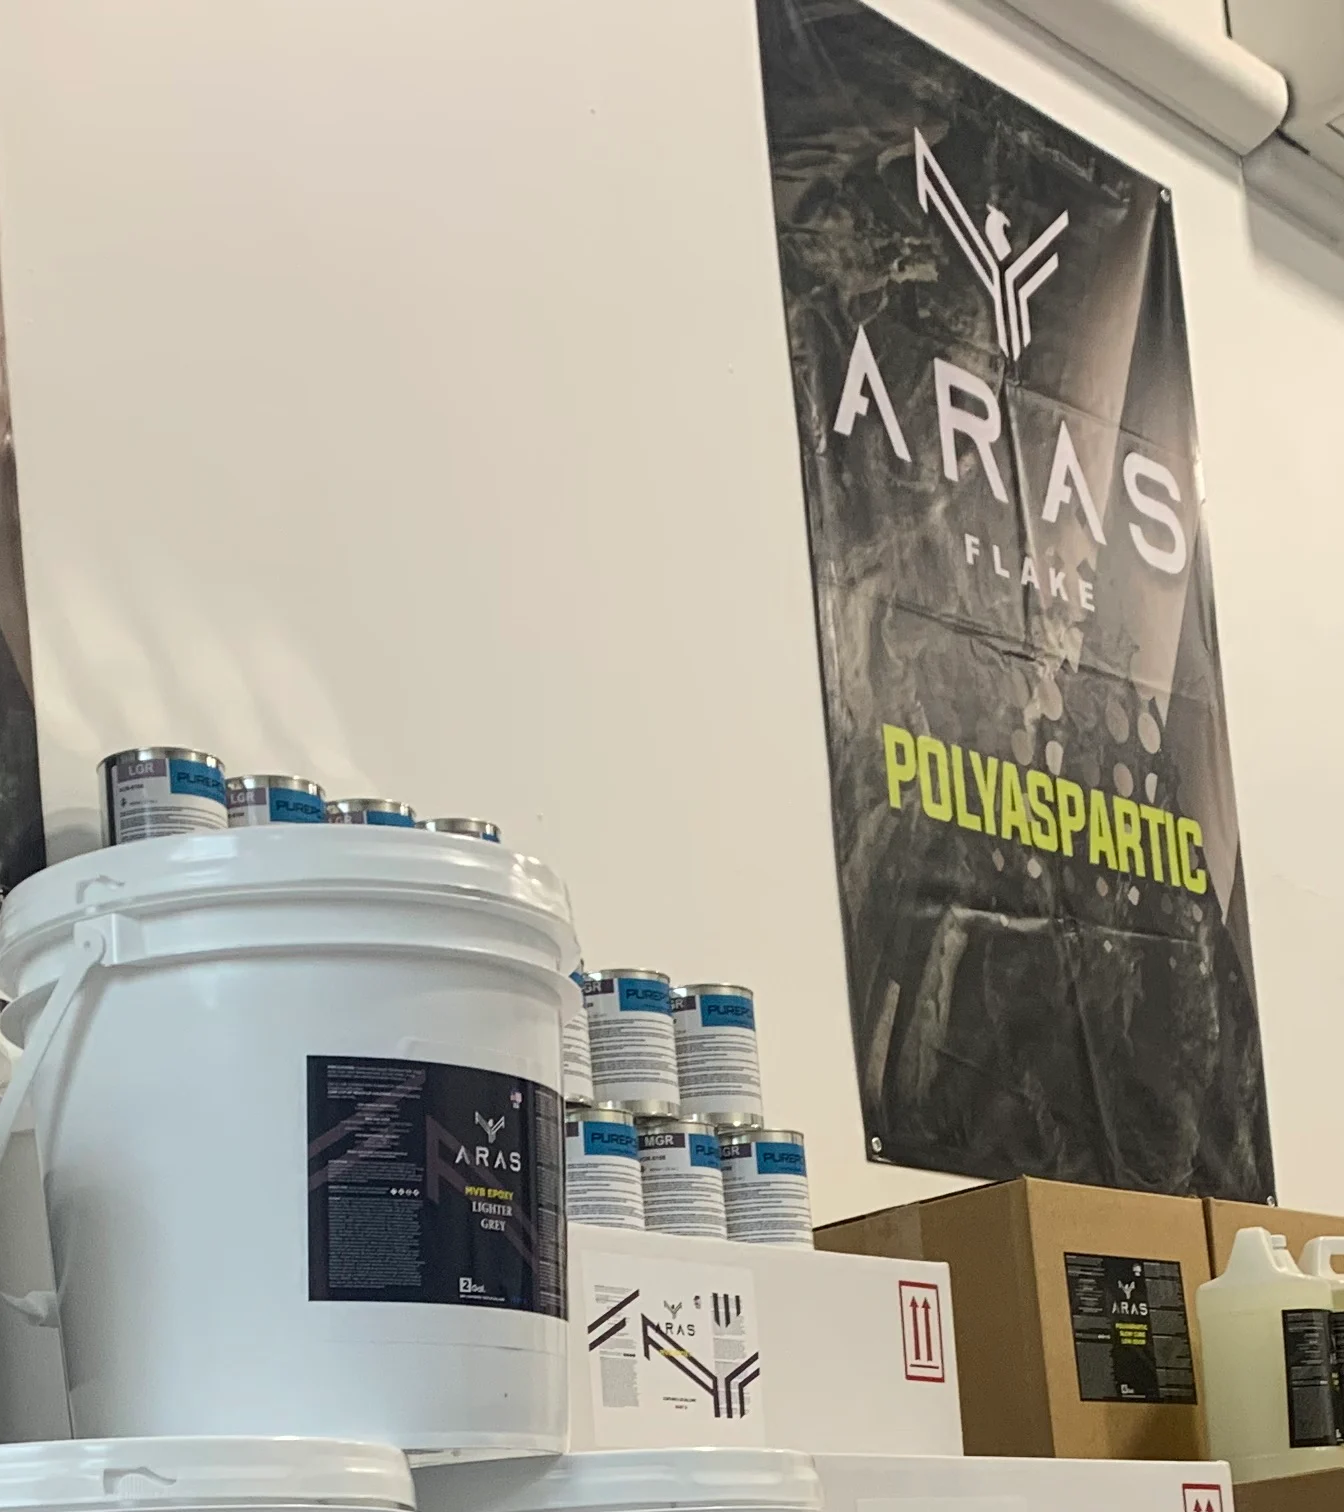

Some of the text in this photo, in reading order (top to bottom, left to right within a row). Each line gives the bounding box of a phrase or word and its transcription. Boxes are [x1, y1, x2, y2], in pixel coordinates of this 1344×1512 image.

[833, 325, 1187, 574] ARAS
[965, 534, 1095, 613] FLAKE
[882, 723, 1207, 894] POLYASPARTIC
[583, 982, 601, 994] GR
[455, 1145, 521, 1172] ARAS
[721, 1145, 740, 1157] GR
[472, 1201, 513, 1217] LIGHTER
[480, 1217, 506, 1232] GREY
[1112, 1301, 1148, 1316] ARAS
